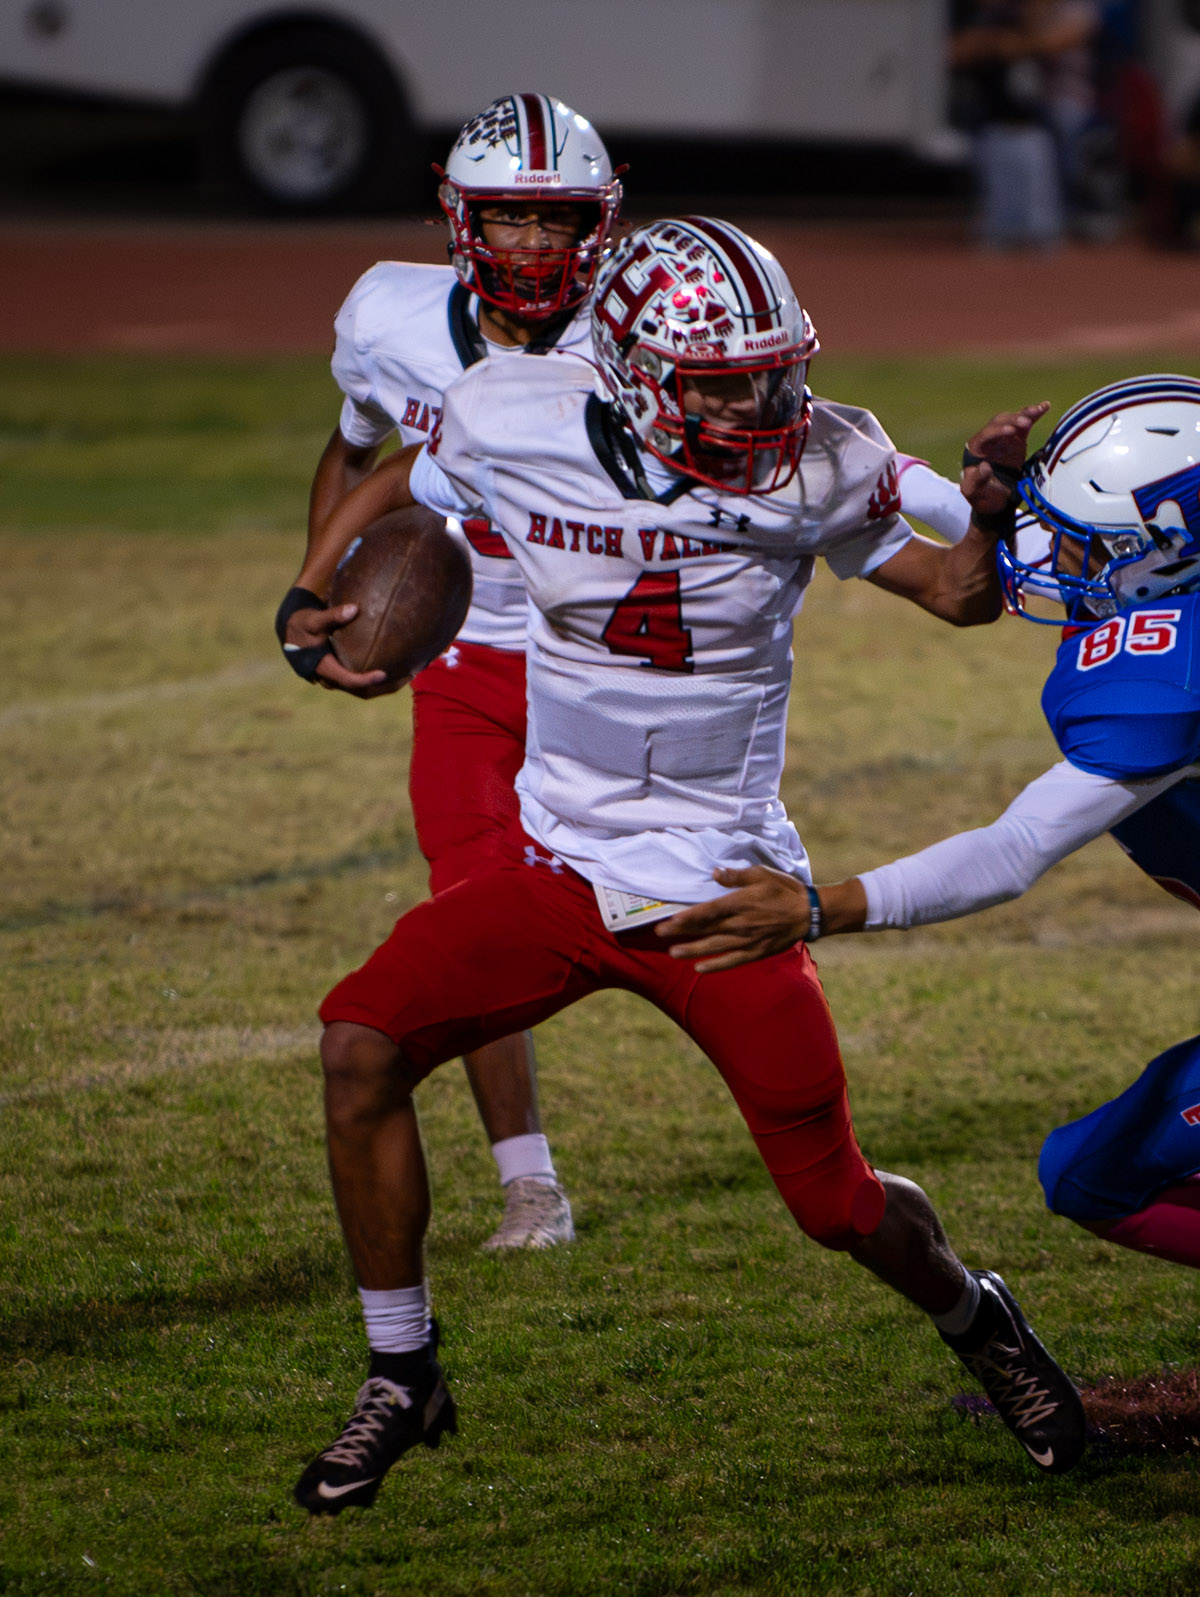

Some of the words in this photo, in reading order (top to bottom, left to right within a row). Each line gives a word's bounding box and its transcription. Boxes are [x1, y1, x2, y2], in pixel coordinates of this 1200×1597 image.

[514, 173, 561, 184] Riddell
[743, 330, 790, 352] Riddell
[526, 511, 624, 558] HATCH
[638, 527, 738, 561] VAL
[601, 569, 695, 674] 4
[1076, 608, 1182, 672] 85
